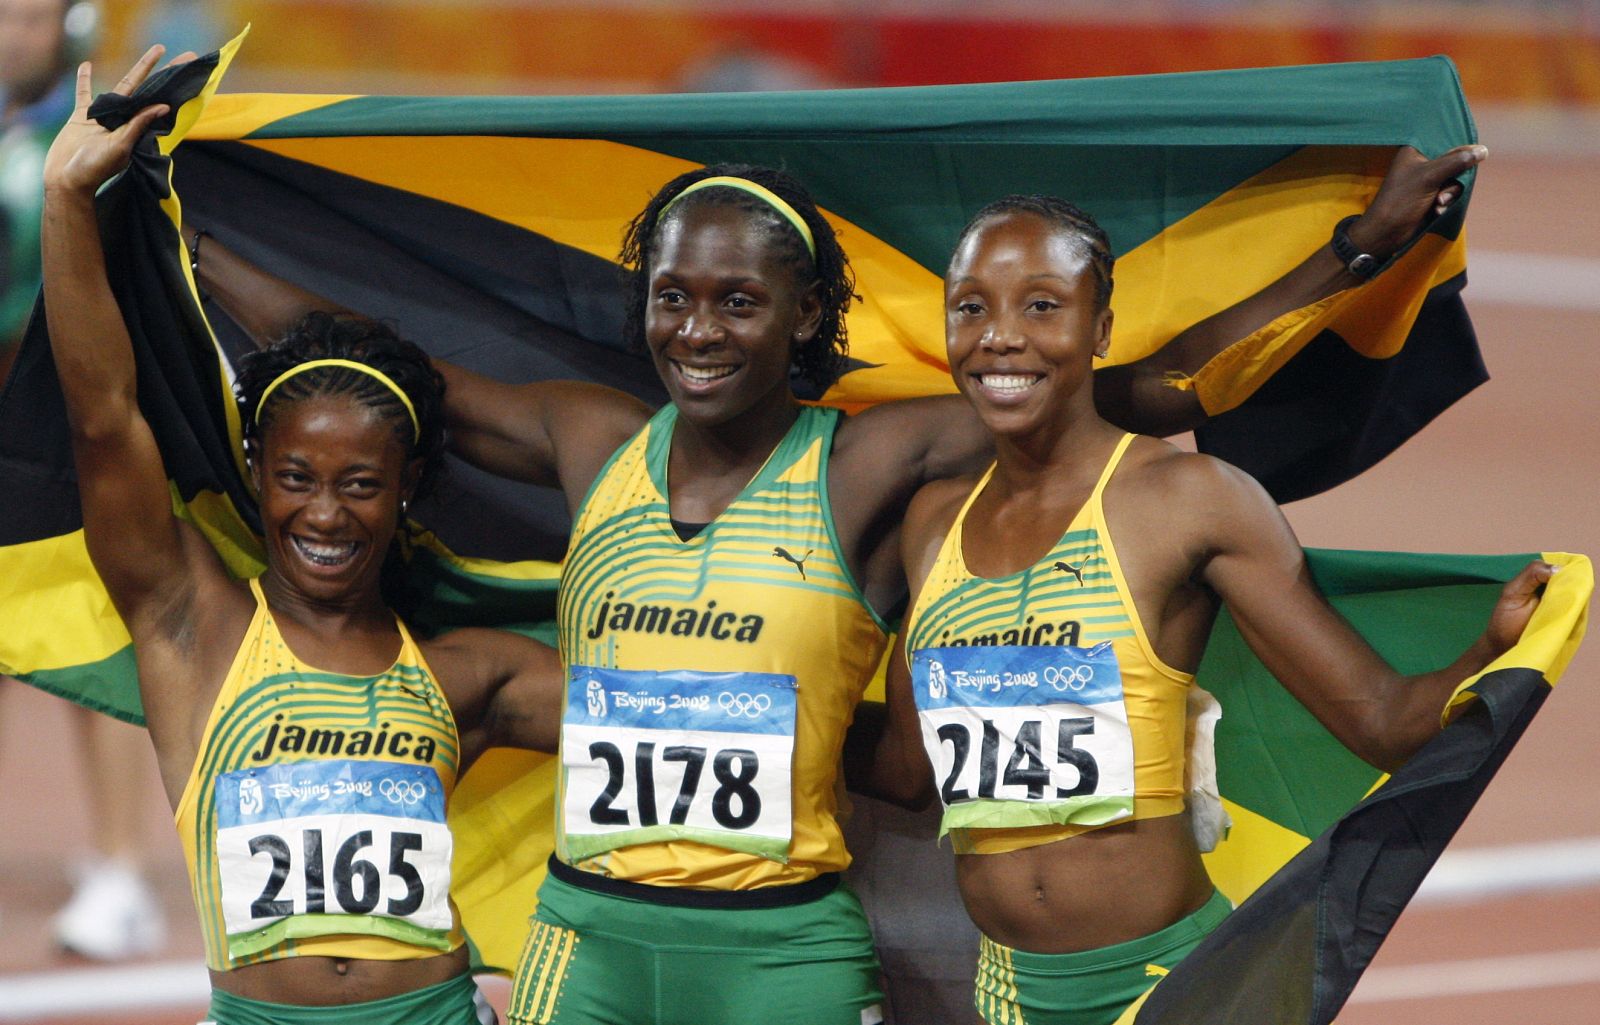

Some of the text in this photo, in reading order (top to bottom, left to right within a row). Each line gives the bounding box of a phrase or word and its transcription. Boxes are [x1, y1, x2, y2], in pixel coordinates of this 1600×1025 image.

[588, 591, 764, 643] jamaica
[610, 691, 710, 713] Beijing 2008
[951, 669, 1038, 691] Beijing 2008
[252, 714, 436, 763] jamaica
[937, 716, 1099, 805] 2145
[269, 780, 373, 801] Beijing 2008
[588, 741, 761, 830] 2178
[248, 829, 425, 919] 2165
